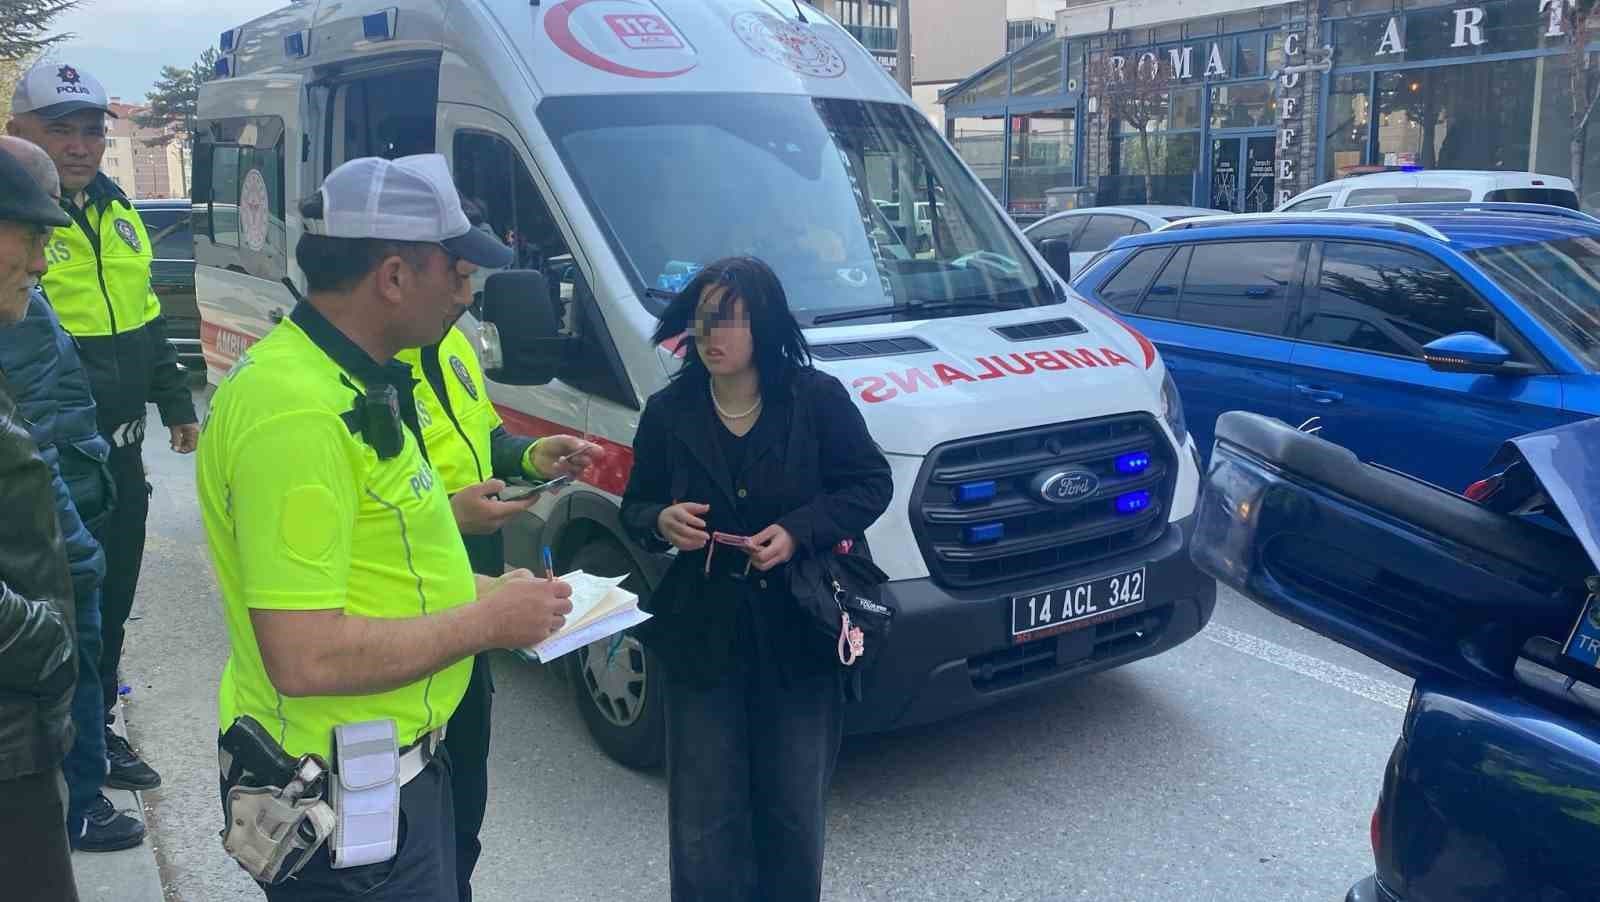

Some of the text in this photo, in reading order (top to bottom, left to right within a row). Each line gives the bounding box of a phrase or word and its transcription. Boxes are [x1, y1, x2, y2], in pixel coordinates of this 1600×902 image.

[615, 17, 666, 35] 112
[1108, 42, 1227, 82] ROMA
[1058, 476, 1089, 497] Ford
[1028, 594, 1052, 626] 14
[1062, 584, 1097, 619] ACL
[1108, 572, 1141, 606] 342
